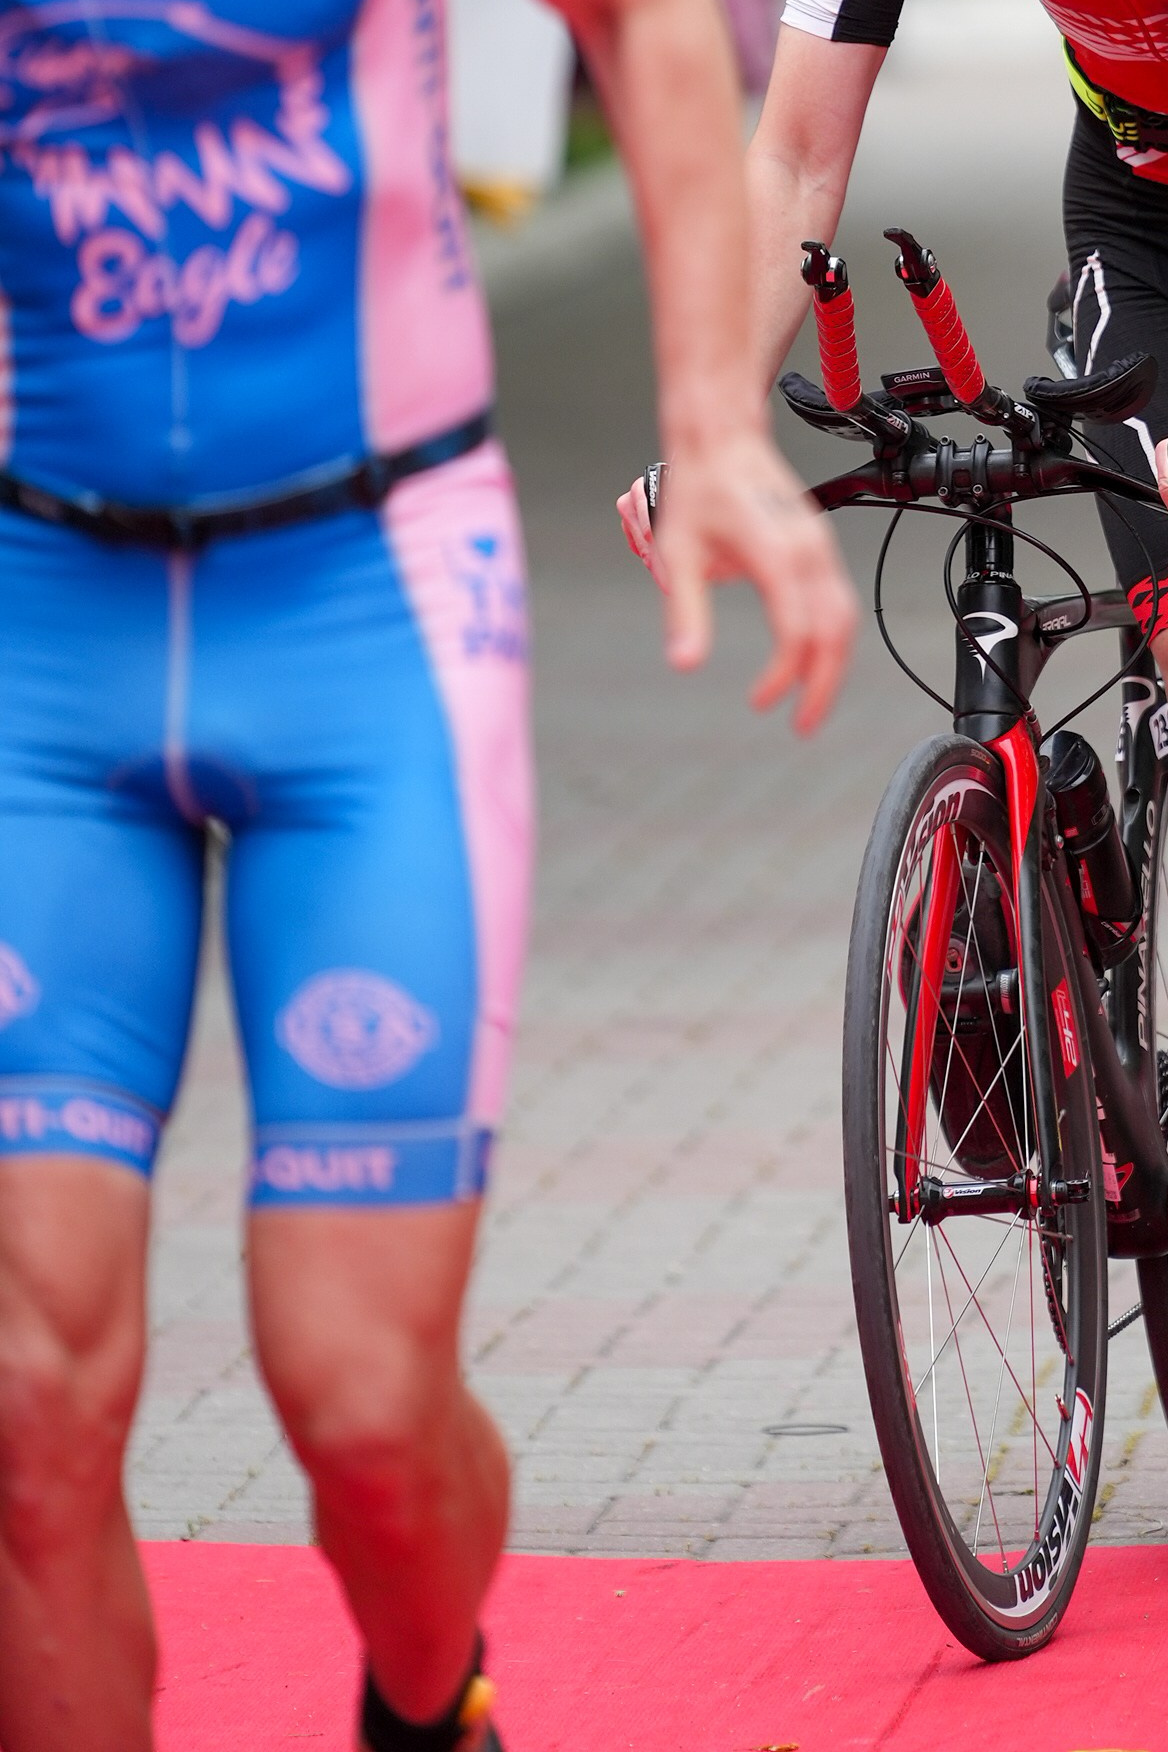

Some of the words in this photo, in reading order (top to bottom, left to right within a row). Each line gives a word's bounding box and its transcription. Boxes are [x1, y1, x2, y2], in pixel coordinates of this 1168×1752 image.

[893, 371, 931, 384] GARMIN
[954, 1187, 982, 1196] Vision
[1016, 1474, 1079, 1603] Vision
